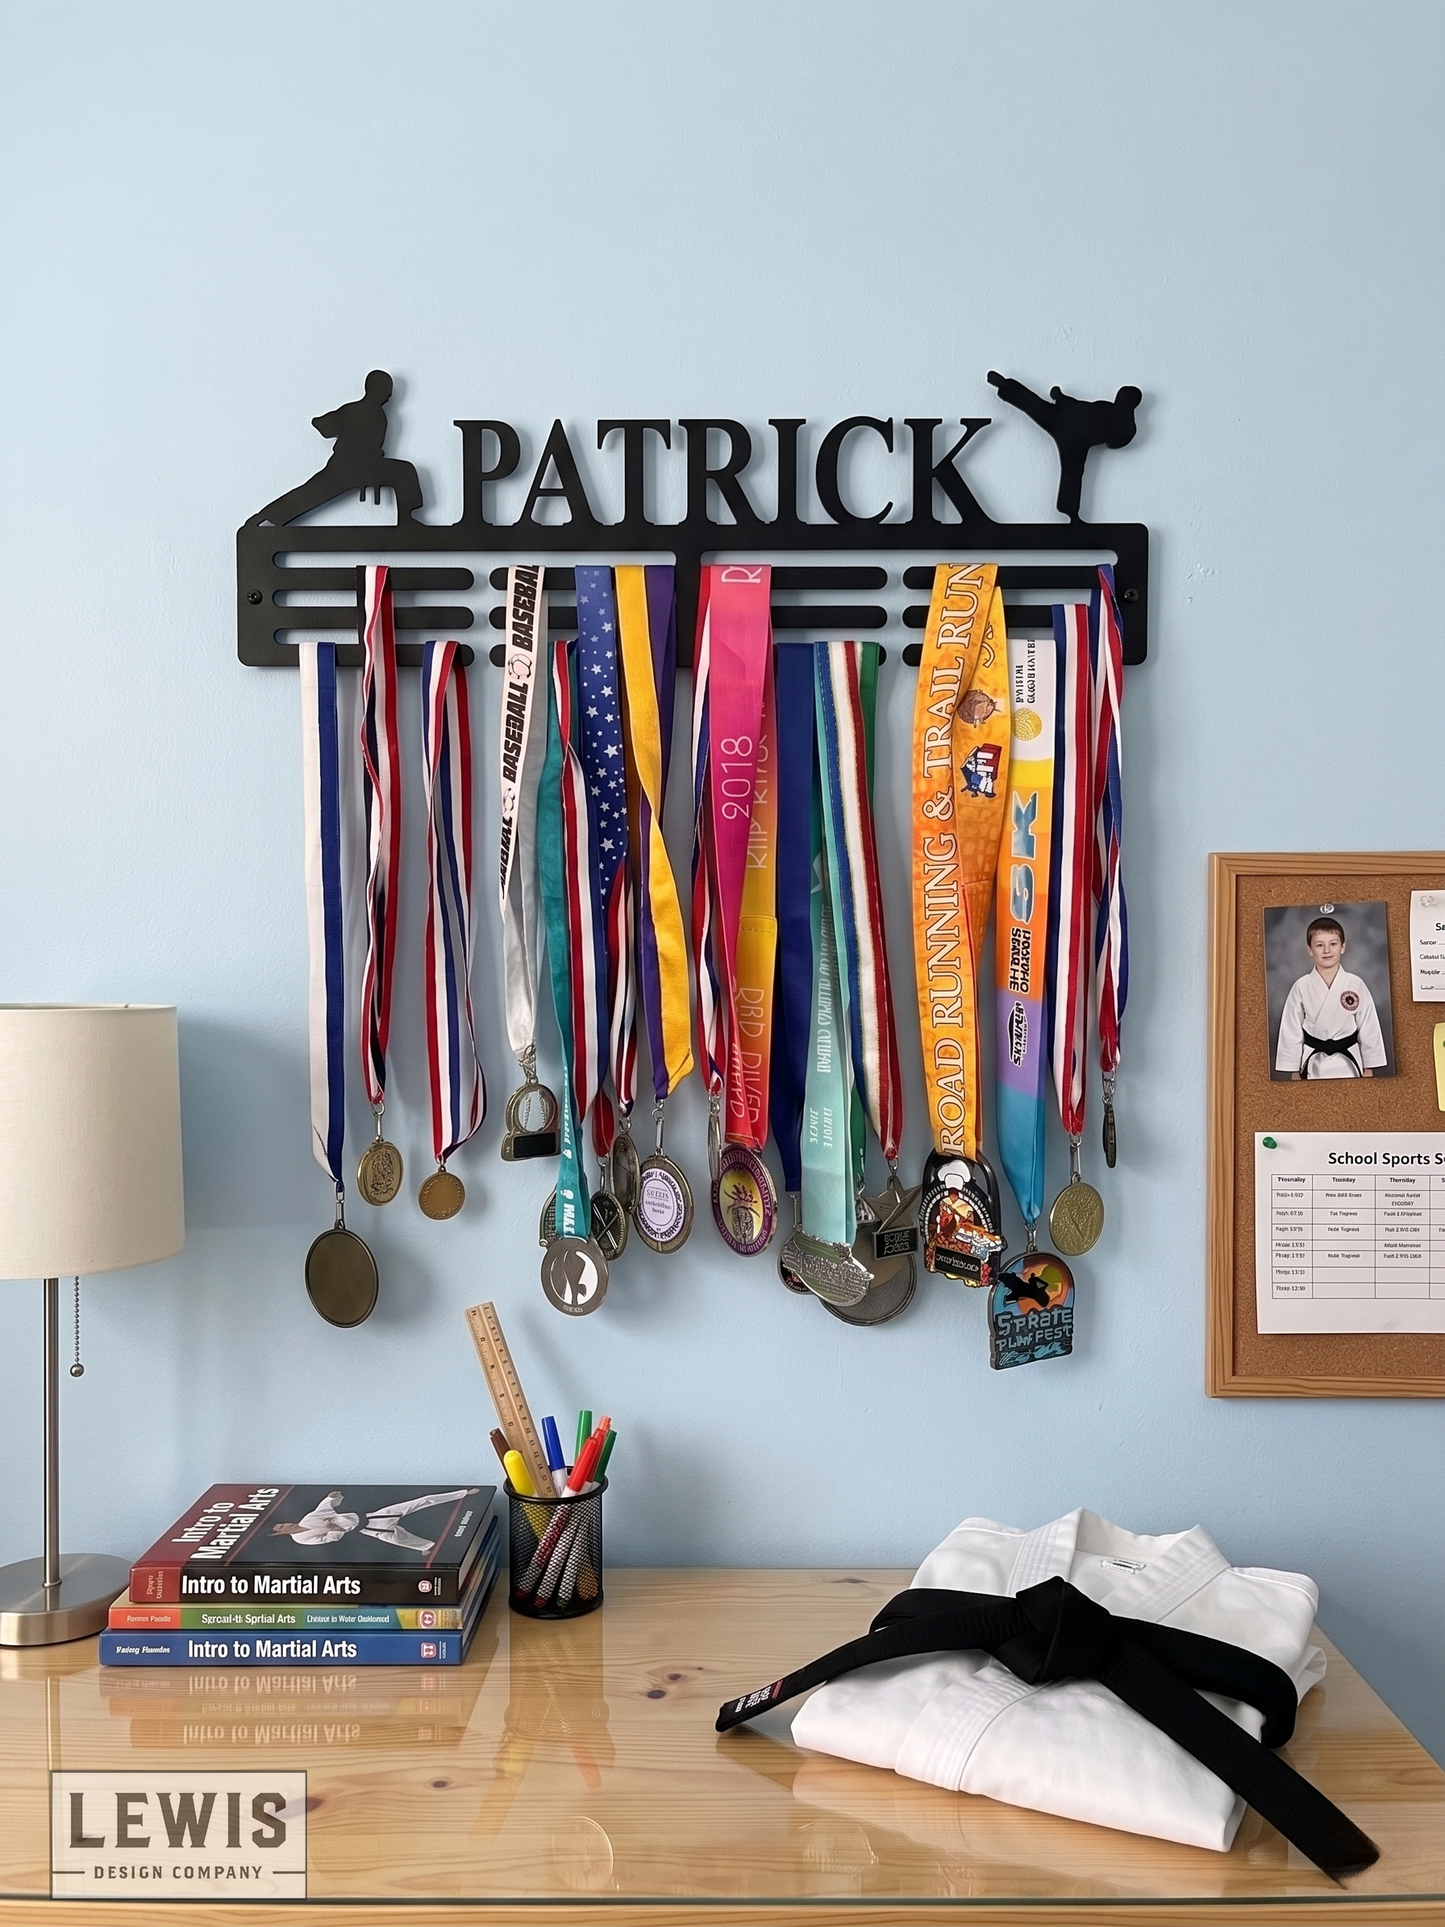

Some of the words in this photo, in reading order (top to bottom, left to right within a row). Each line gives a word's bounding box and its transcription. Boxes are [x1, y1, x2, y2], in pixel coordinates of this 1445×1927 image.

[452, 415, 992, 526] PATRICK
[922, 657, 965, 778] TRAIL
[720, 735, 753, 820] 2018
[921, 786, 954, 822] &
[923, 832, 963, 1028] RUNNING
[934, 1038, 966, 1155] ROAD
[1328, 1151, 1377, 1165] School
[1382, 1152, 1430, 1168] Sports
[171, 1515, 223, 1543] Intro
[203, 1502, 236, 1514] to
[189, 1512, 260, 1559] Martial
[238, 1487, 280, 1511] Arts
[182, 1574, 226, 1595] Intro
[230, 1576, 249, 1595] to
[253, 1574, 319, 1595] Martial
[323, 1575, 362, 1595] Arts
[277, 1613, 296, 1624] Arts
[188, 1640, 228, 1658] Intro
[233, 1641, 250, 1658] to
[255, 1639, 317, 1658] Martial
[321, 1640, 357, 1658] Arts
